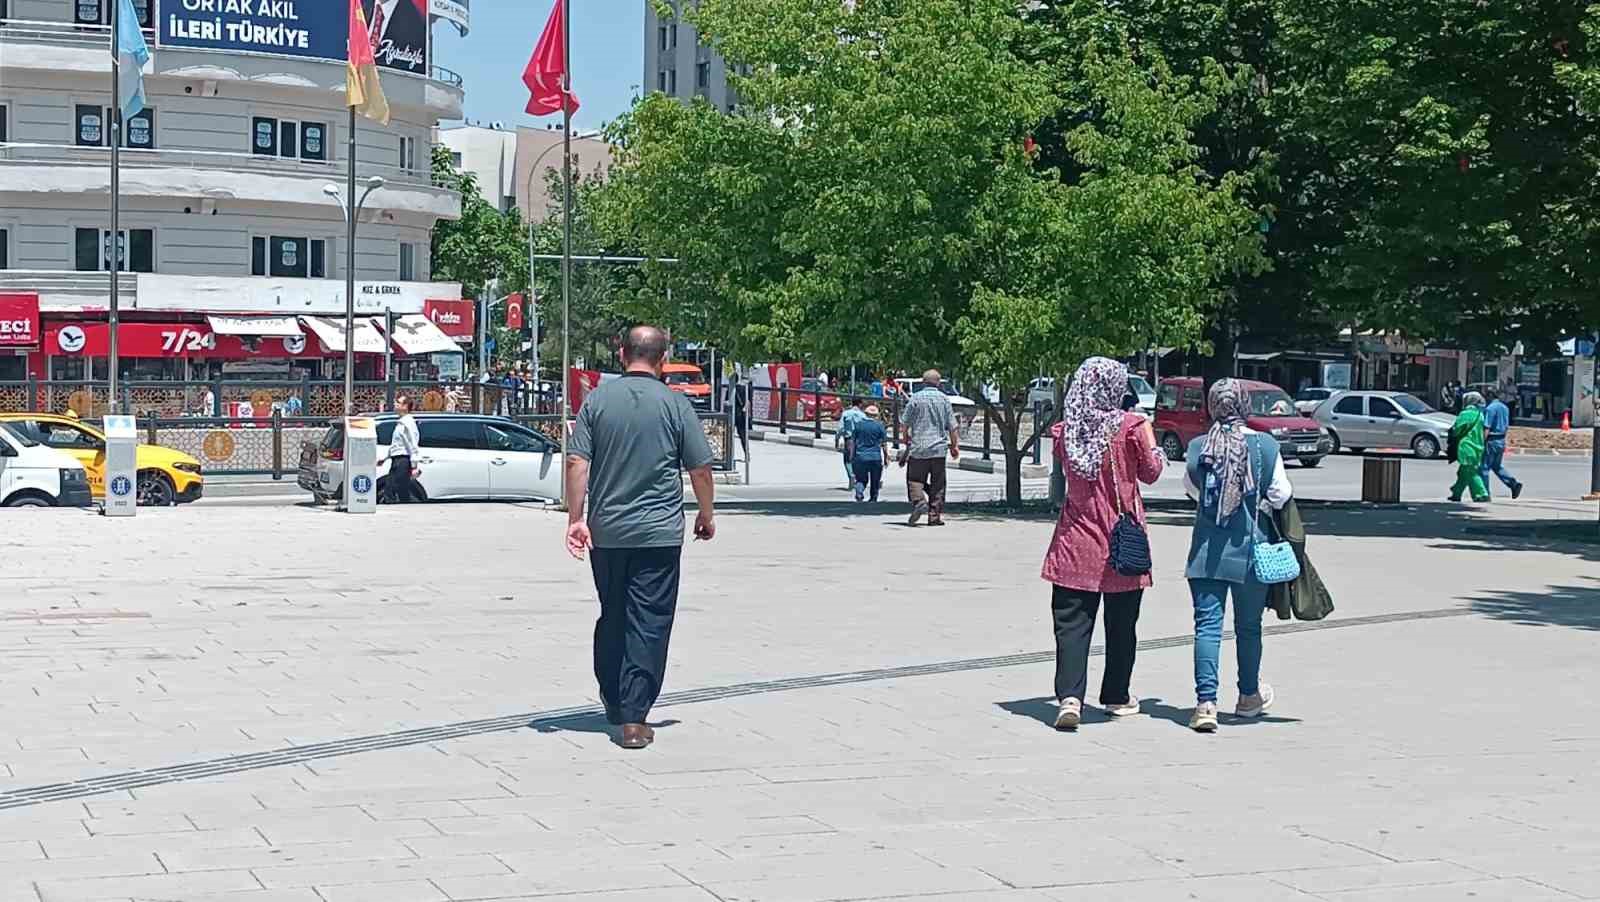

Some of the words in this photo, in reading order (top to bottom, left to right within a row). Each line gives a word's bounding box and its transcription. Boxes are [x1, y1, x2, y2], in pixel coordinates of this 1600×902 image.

[183, 0, 252, 15] ORTAK
[258, 2, 298, 20] AKIL
[170, 14, 221, 41] İLERİ
[226, 21, 309, 48] TÜRKİYE
[161, 328, 216, 352] 7/24
